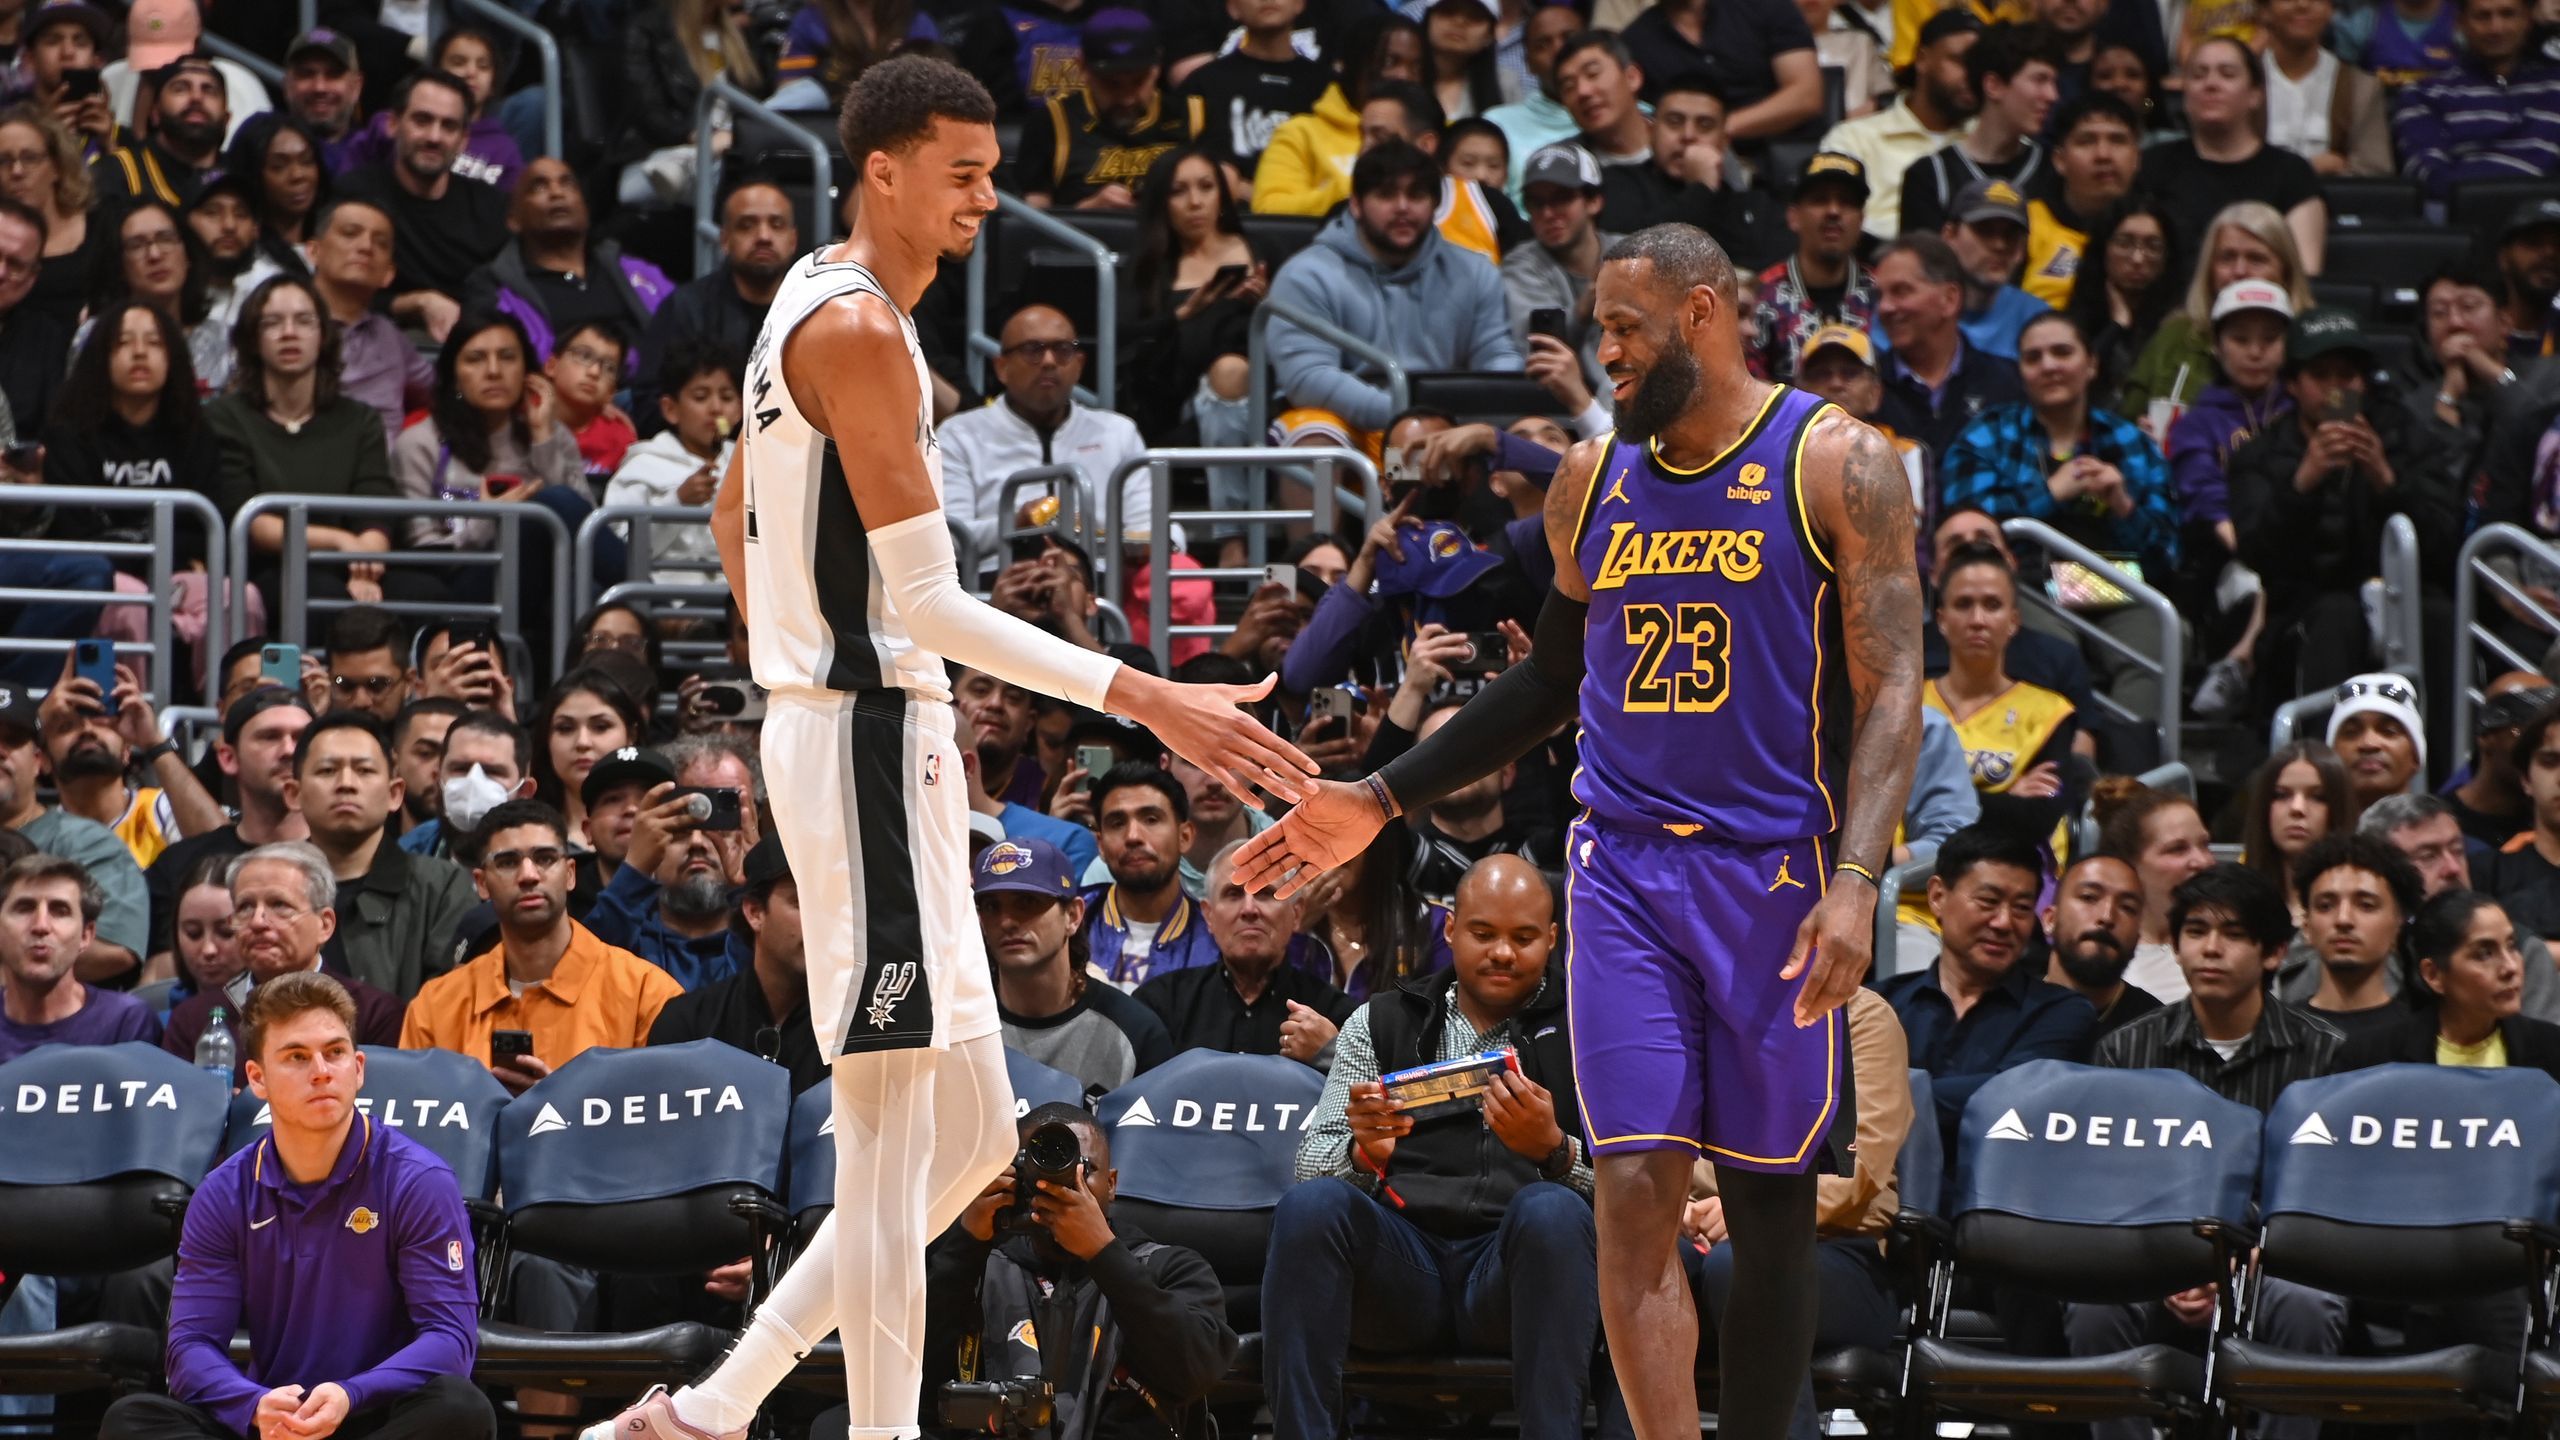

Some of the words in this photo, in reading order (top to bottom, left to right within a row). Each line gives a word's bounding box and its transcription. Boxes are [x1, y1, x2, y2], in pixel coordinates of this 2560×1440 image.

[1727, 486, 1771, 504] bibigo
[1591, 522, 1765, 591] LAKERS
[1623, 603, 1731, 713] 23
[17, 1081, 176, 1113] DELTA
[353, 1098, 470, 1130] ELTA
[583, 1086, 744, 1126] DELTA
[2046, 1113, 2212, 1149] DELTA
[2350, 1115, 2521, 1149] DELTA
